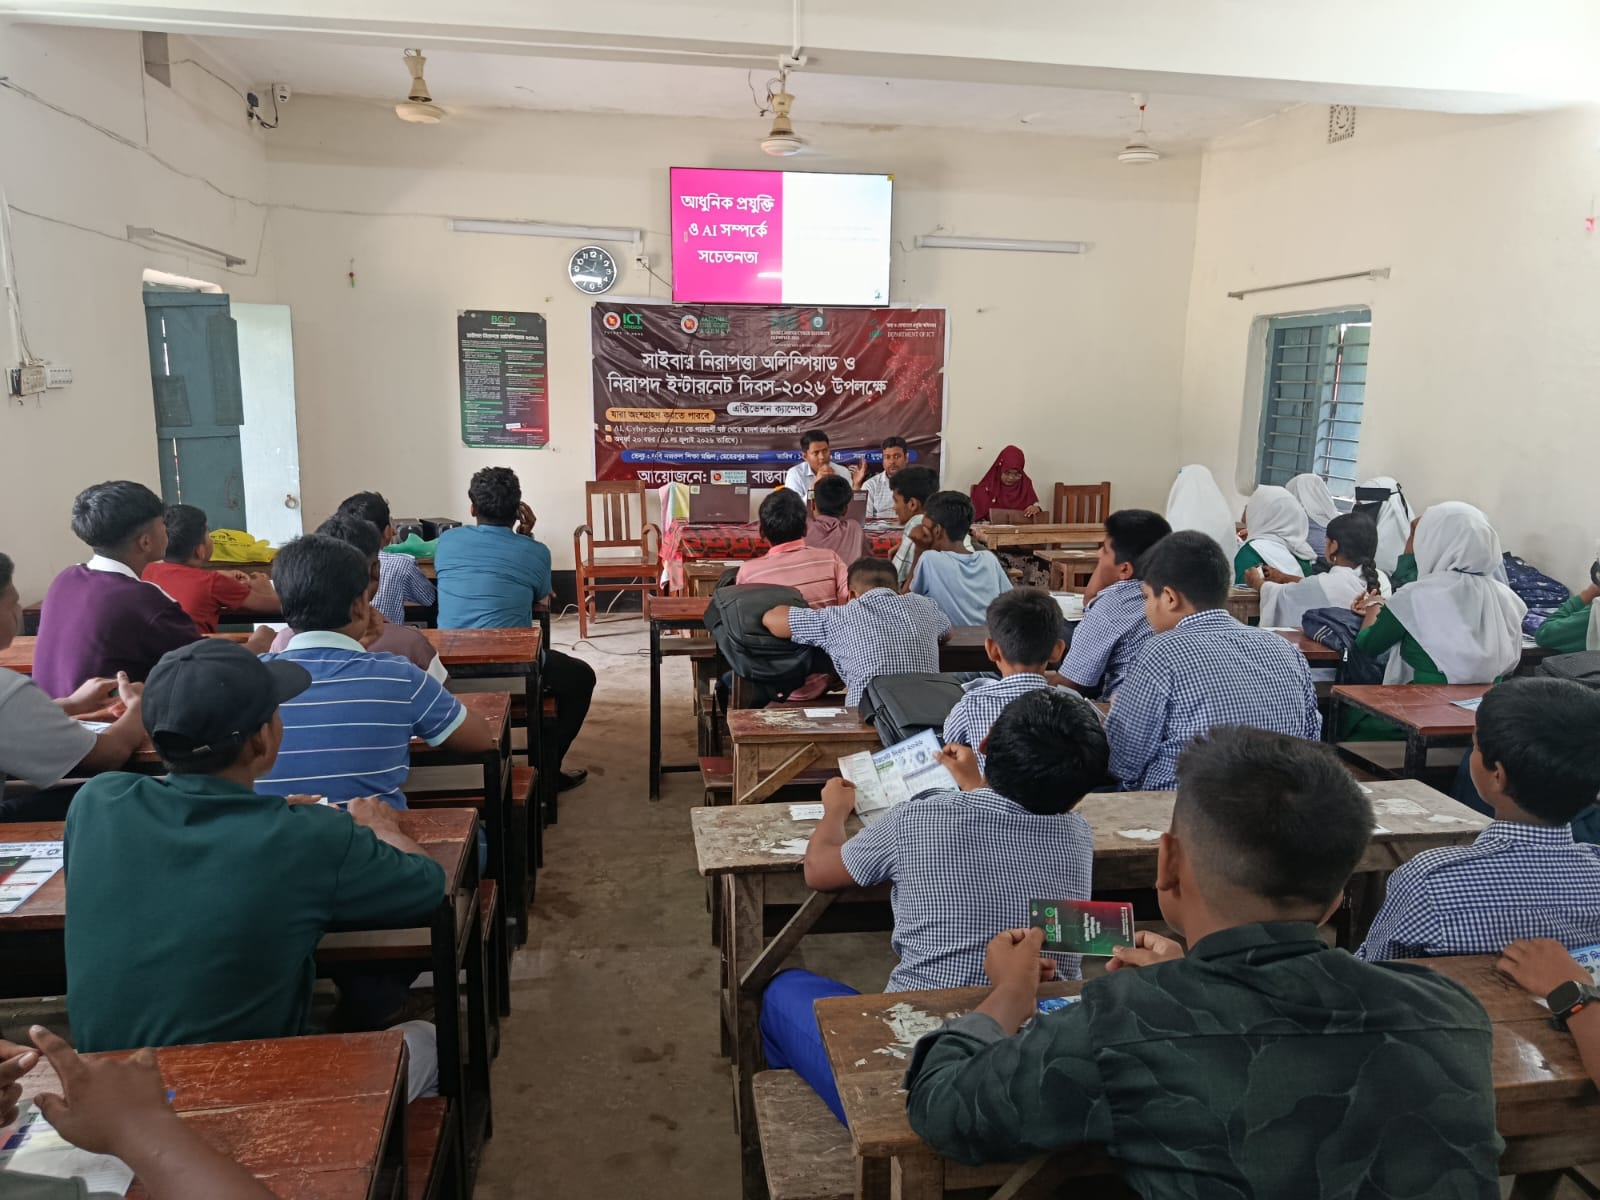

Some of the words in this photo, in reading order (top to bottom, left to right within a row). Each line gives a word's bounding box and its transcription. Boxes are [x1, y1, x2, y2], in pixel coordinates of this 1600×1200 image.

[680, 193, 733, 212] আধুনিক
[736, 194, 776, 214] প্রযুক্তি
[688, 223, 699, 236] ও
[702, 225, 717, 236] AI
[720, 220, 768, 238] সম্পর্কে
[698, 250, 759, 264] সচেতনতা
[623, 313, 642, 325] ICT
[641, 349, 694, 370] সাইবার
[700, 350, 758, 371] নিরাপত্তা
[760, 350, 839, 372] অলিম্পিয়াড
[844, 357, 856, 370] ও
[606, 371, 662, 394] নিরাপদ
[666, 373, 734, 395] ইন্টারনেট
[738, 374, 826, 395] দিবস-২০২৬
[832, 376, 888, 396] উপলক্ষে
[751, 470, 788, 484] বাস্তবা
